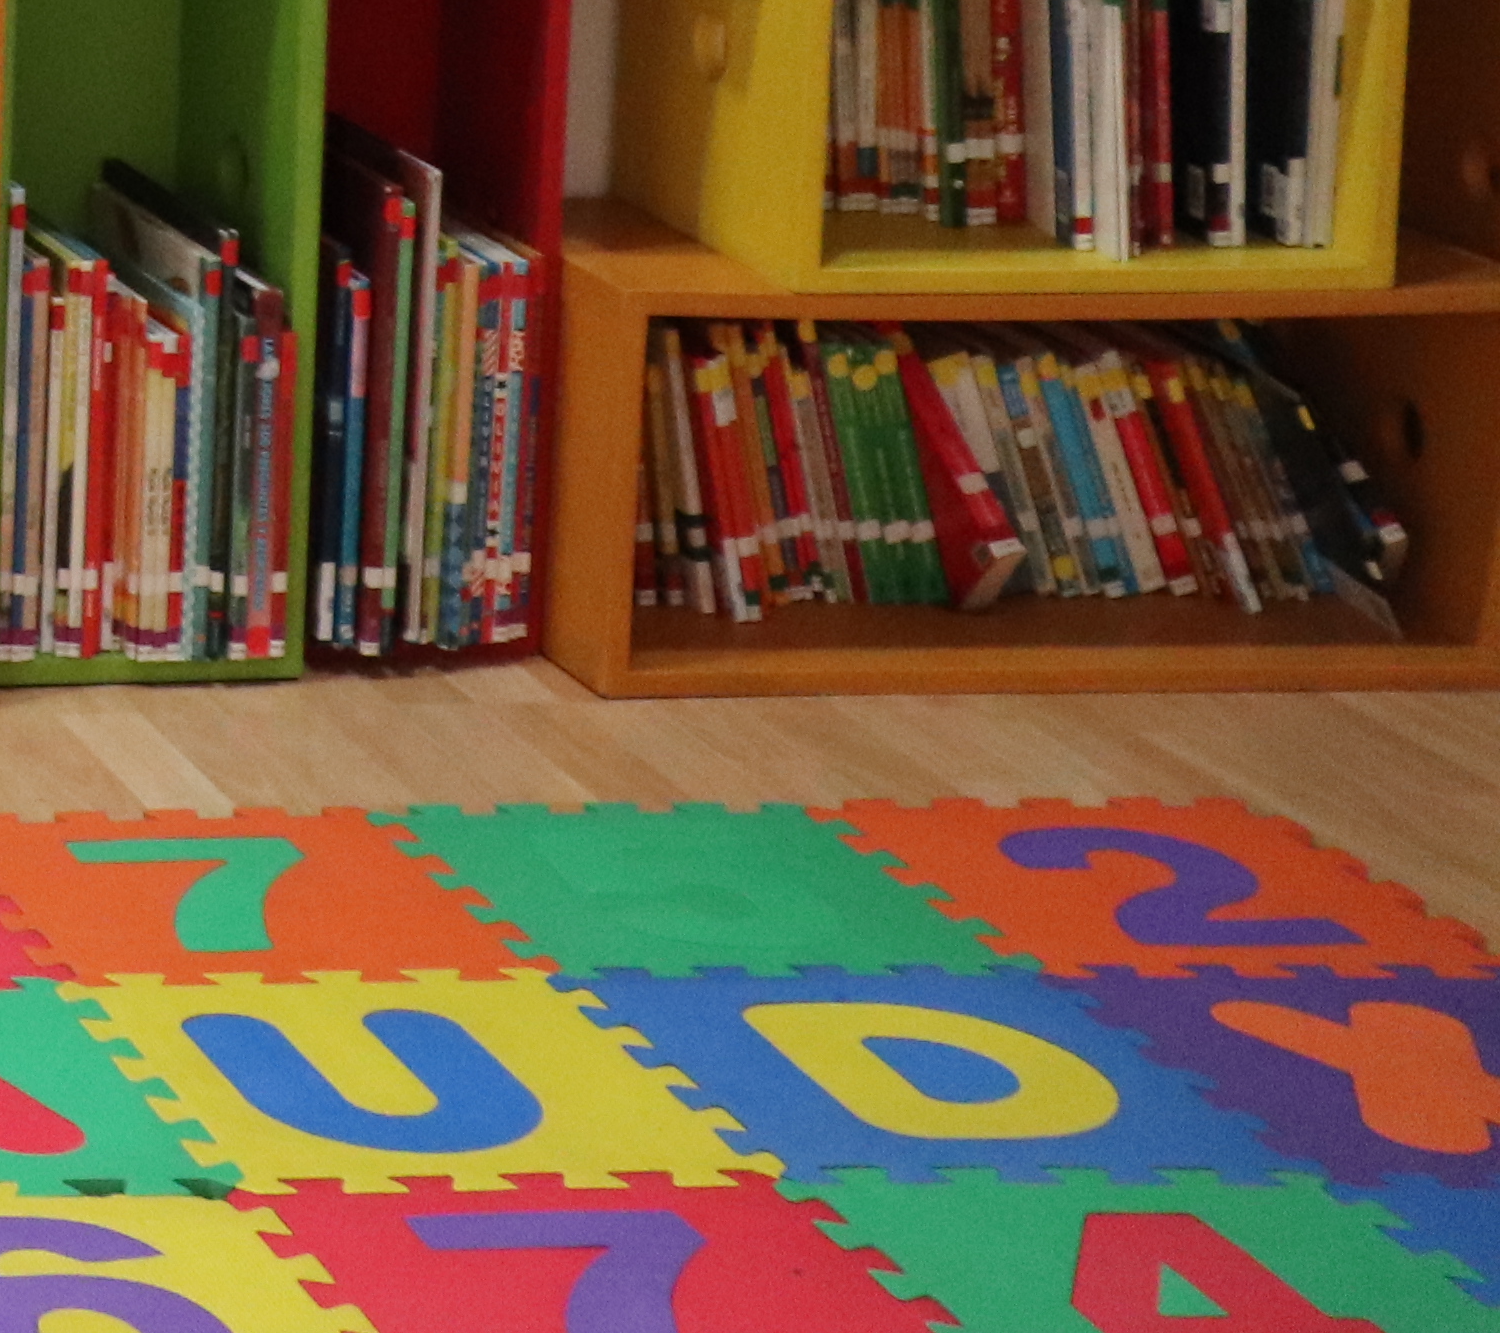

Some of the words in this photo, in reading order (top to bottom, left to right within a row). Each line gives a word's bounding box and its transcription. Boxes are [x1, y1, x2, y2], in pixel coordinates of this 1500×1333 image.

[64, 835, 305, 952] 7
[996, 825, 1367, 947] 2
[179, 1008, 545, 1155] U
[740, 1002, 1120, 1140] D
[403, 1208, 706, 1333] 7
